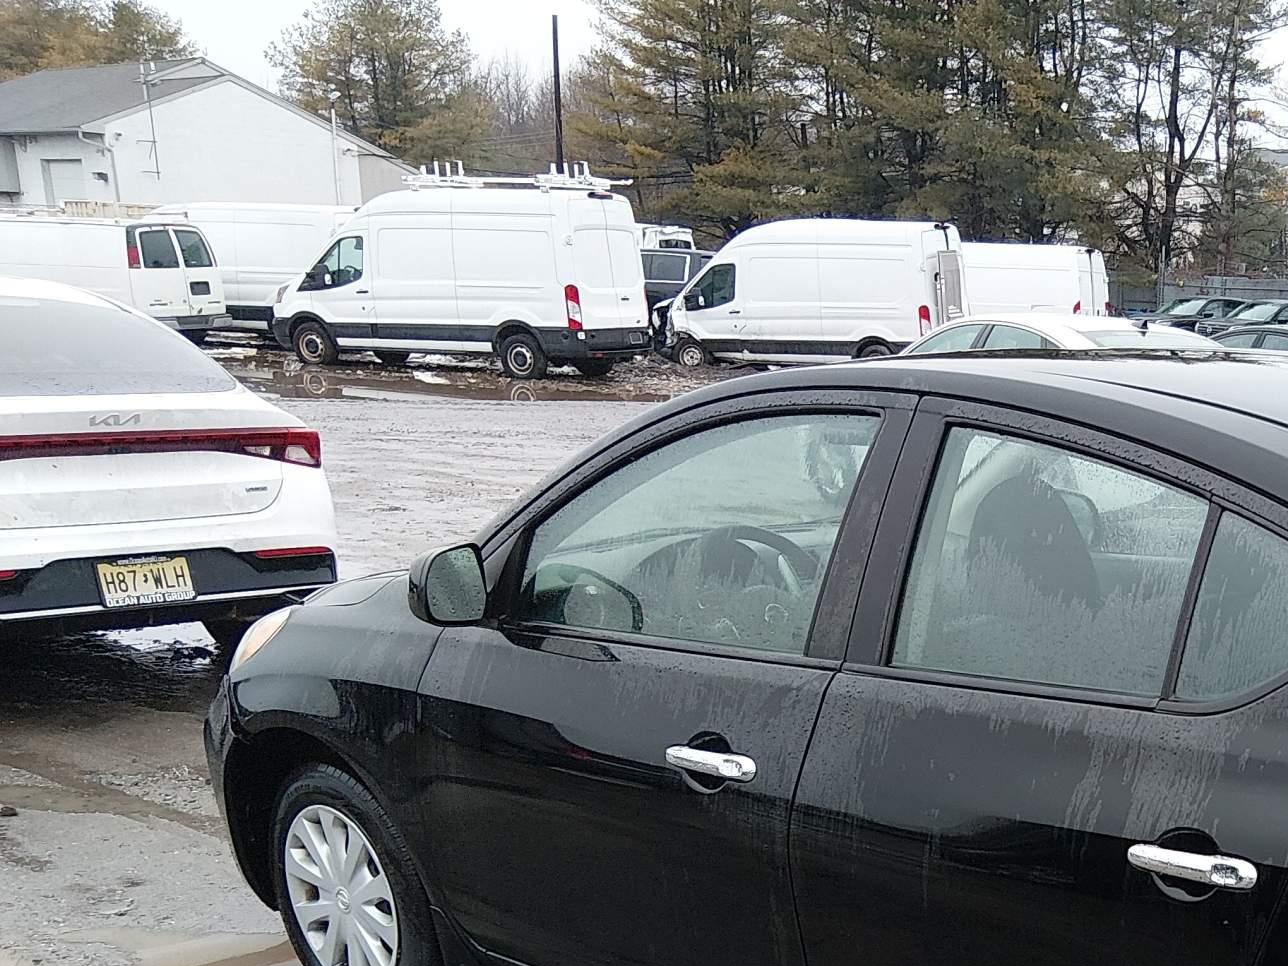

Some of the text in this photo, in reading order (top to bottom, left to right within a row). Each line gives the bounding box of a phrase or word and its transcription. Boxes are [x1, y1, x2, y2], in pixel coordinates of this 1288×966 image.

[89, 413, 141, 427] KIA
[103, 565, 187, 594] H87 WLH
[106, 590, 195, 607] OCEAN AUTO GROUP
